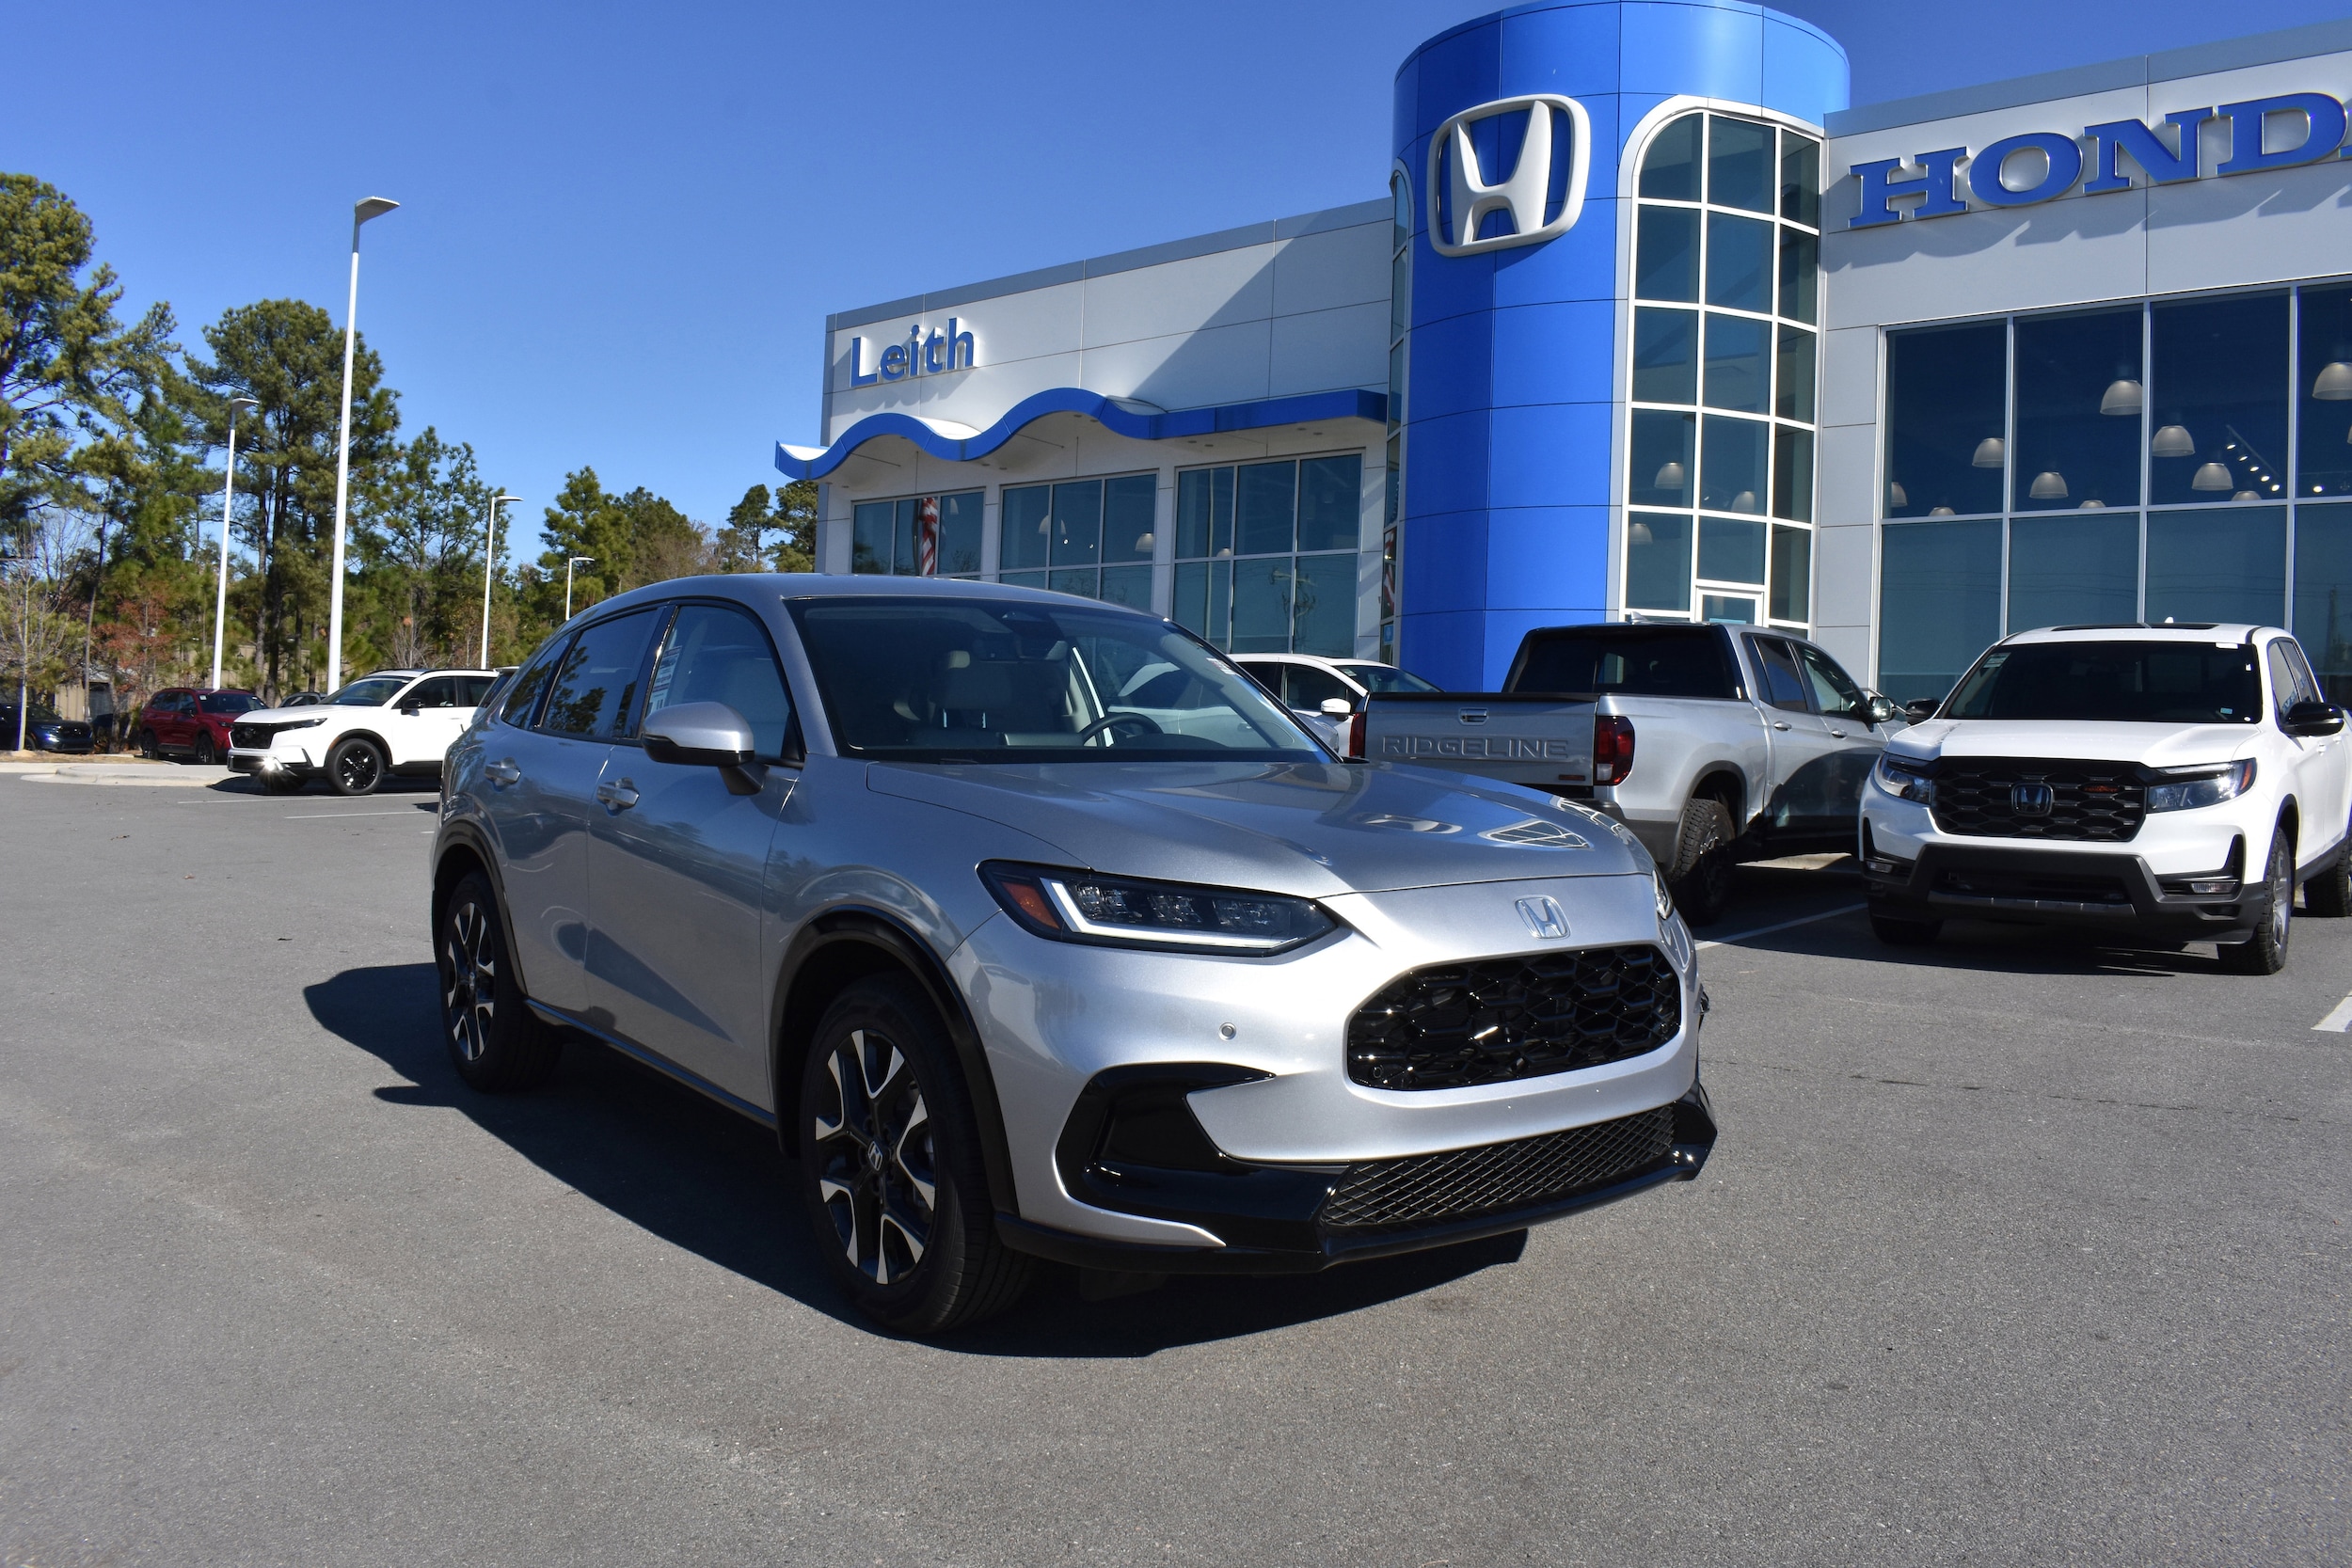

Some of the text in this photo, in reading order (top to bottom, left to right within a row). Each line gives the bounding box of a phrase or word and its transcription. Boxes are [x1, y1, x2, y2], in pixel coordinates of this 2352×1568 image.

[1849, 91, 2352, 229] HOND
[850, 317, 977, 388] Leith
[1382, 736, 1570, 760] RIDGELINE
